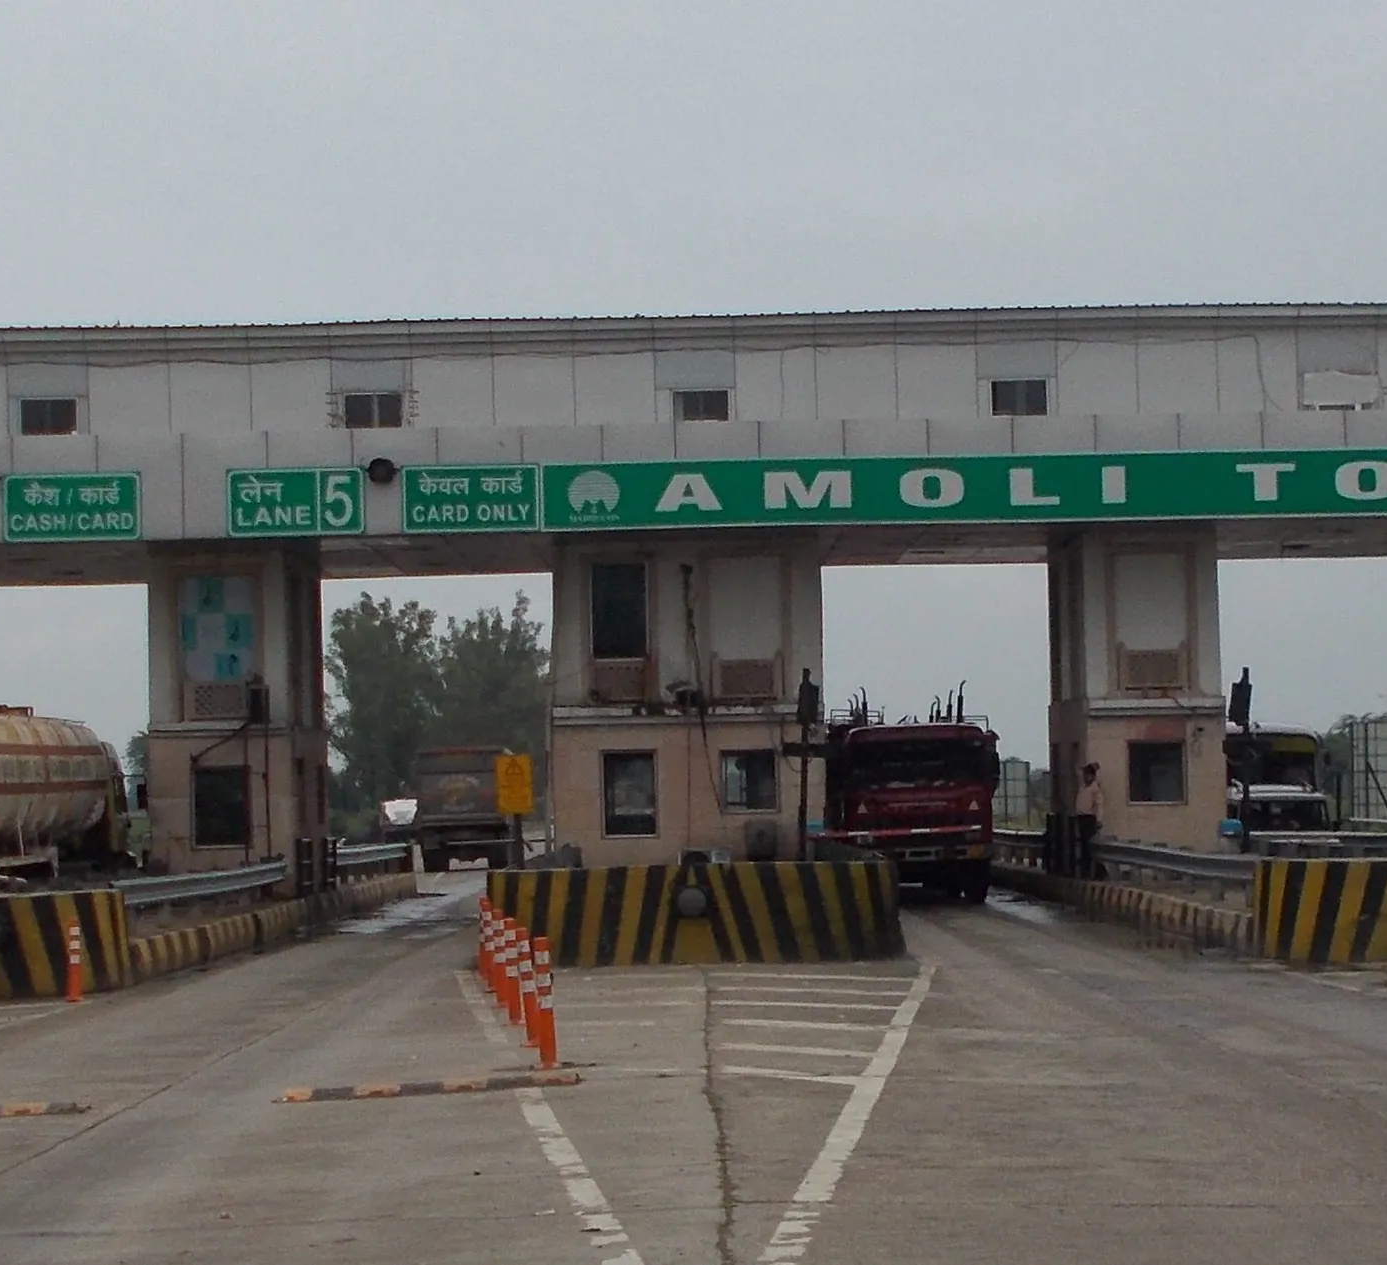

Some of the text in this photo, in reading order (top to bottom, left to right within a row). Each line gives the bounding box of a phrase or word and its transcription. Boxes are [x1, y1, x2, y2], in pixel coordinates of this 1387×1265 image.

[23, 482, 61, 506] कैश
[78, 480, 121, 505] कार्ड
[237, 475, 283, 503] लेन
[418, 470, 523, 496] केवल कार्ड
[655, 466, 1128, 512] AMOLI
[324, 474, 353, 527] 5
[412, 503, 530, 523] CARD ONLY
[10, 512, 134, 532] CASH/CARD
[236, 505, 312, 527] LANE
